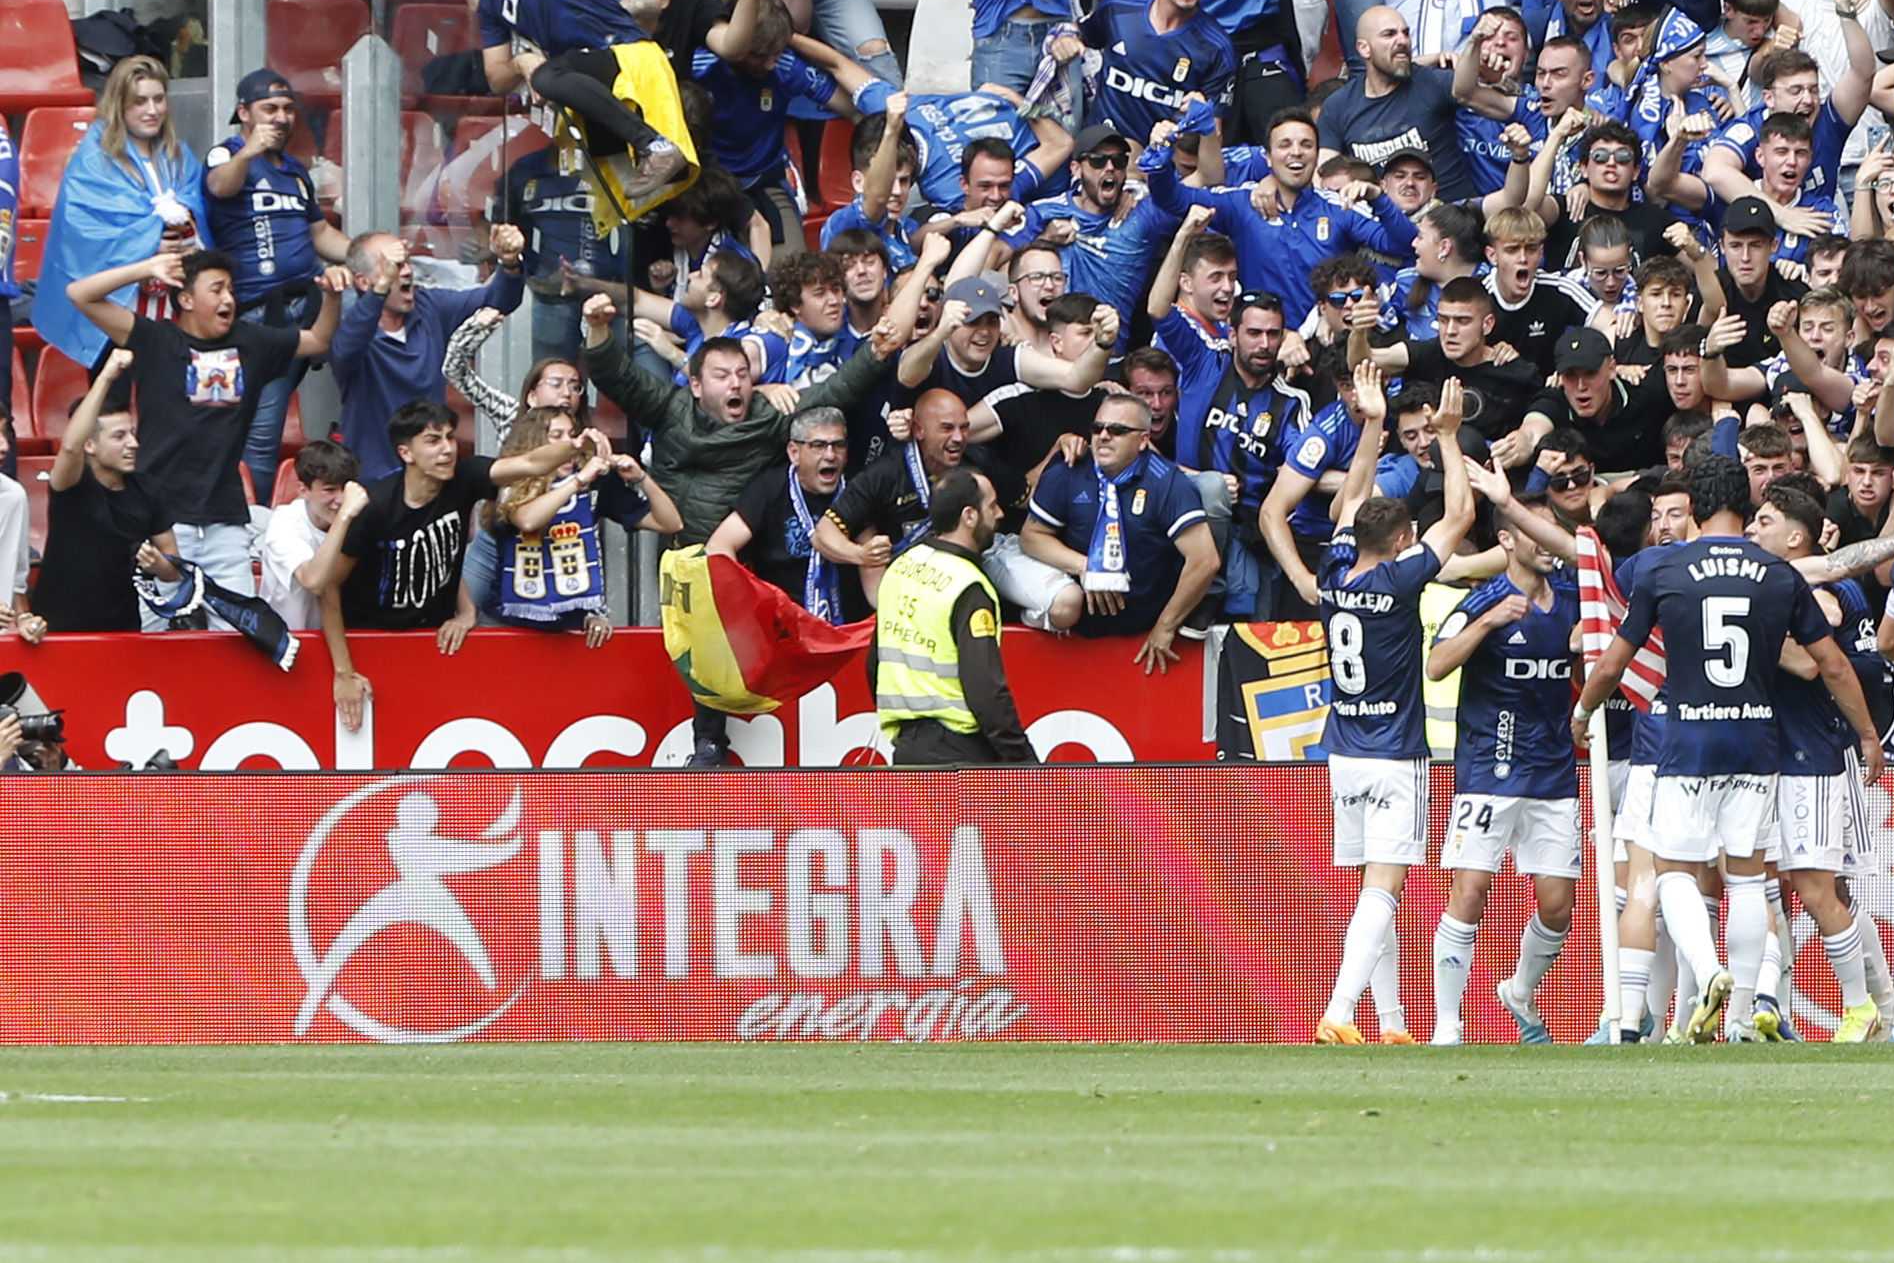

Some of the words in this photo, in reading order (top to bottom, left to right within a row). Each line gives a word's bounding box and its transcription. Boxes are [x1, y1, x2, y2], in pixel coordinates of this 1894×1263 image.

[1106, 66, 1184, 108] DIGI
[1687, 556, 1768, 583] LUISMI
[1329, 611, 1367, 695] 8
[1701, 596, 1751, 689] 5
[1506, 658, 1571, 680] DIG
[1305, 683, 1325, 708] R
[1360, 700, 1397, 717] Auto
[1679, 703, 1740, 721] Tartiere
[1742, 703, 1774, 720] Auto
[1456, 800, 1493, 836] 24
[540, 825, 1007, 979] INTEGRA
[737, 980, 1030, 1044] energía
